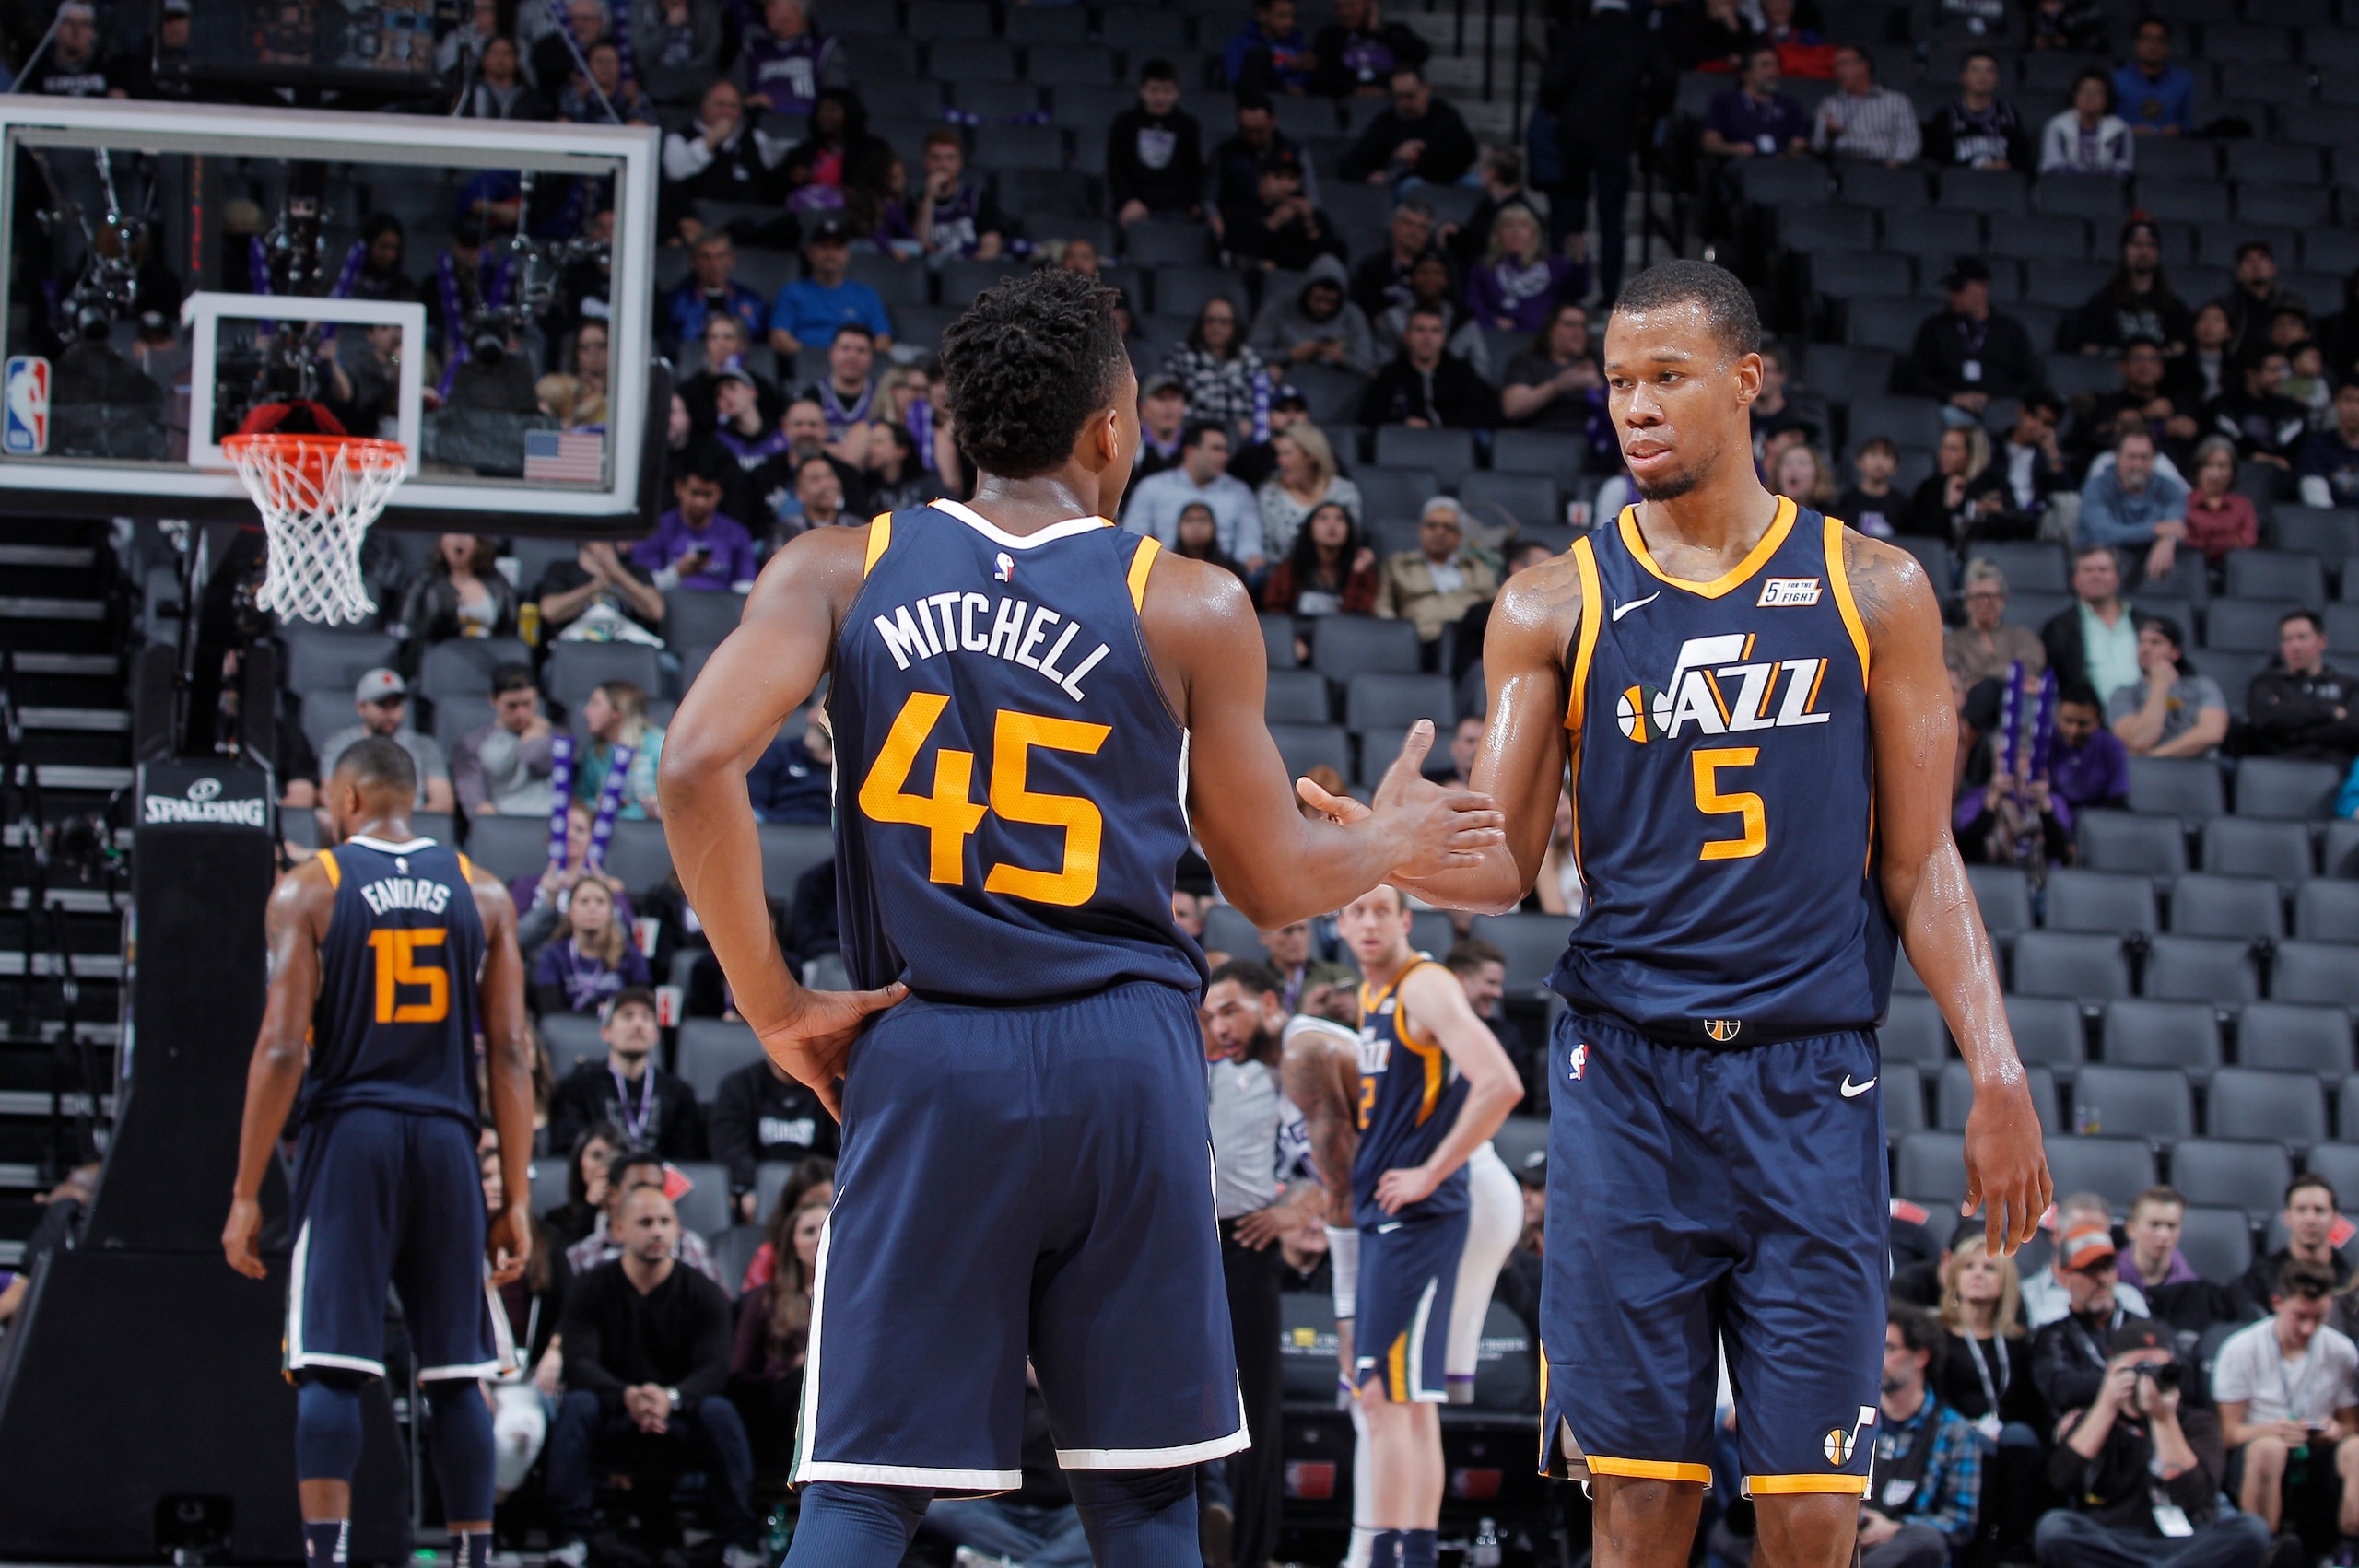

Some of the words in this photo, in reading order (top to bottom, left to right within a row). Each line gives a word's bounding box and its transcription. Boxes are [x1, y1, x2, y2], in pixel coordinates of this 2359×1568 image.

[1765, 582, 1780, 603] 5
[1781, 592, 1816, 603] FIGHT
[874, 591, 1111, 703] MITCHELL
[1616, 632, 1832, 743] JAZZ
[145, 794, 265, 828] SPALDING
[858, 691, 1113, 907] 45
[1691, 746, 1767, 861] 5
[359, 877, 452, 917] FAVORS
[367, 927, 450, 1024] 15
